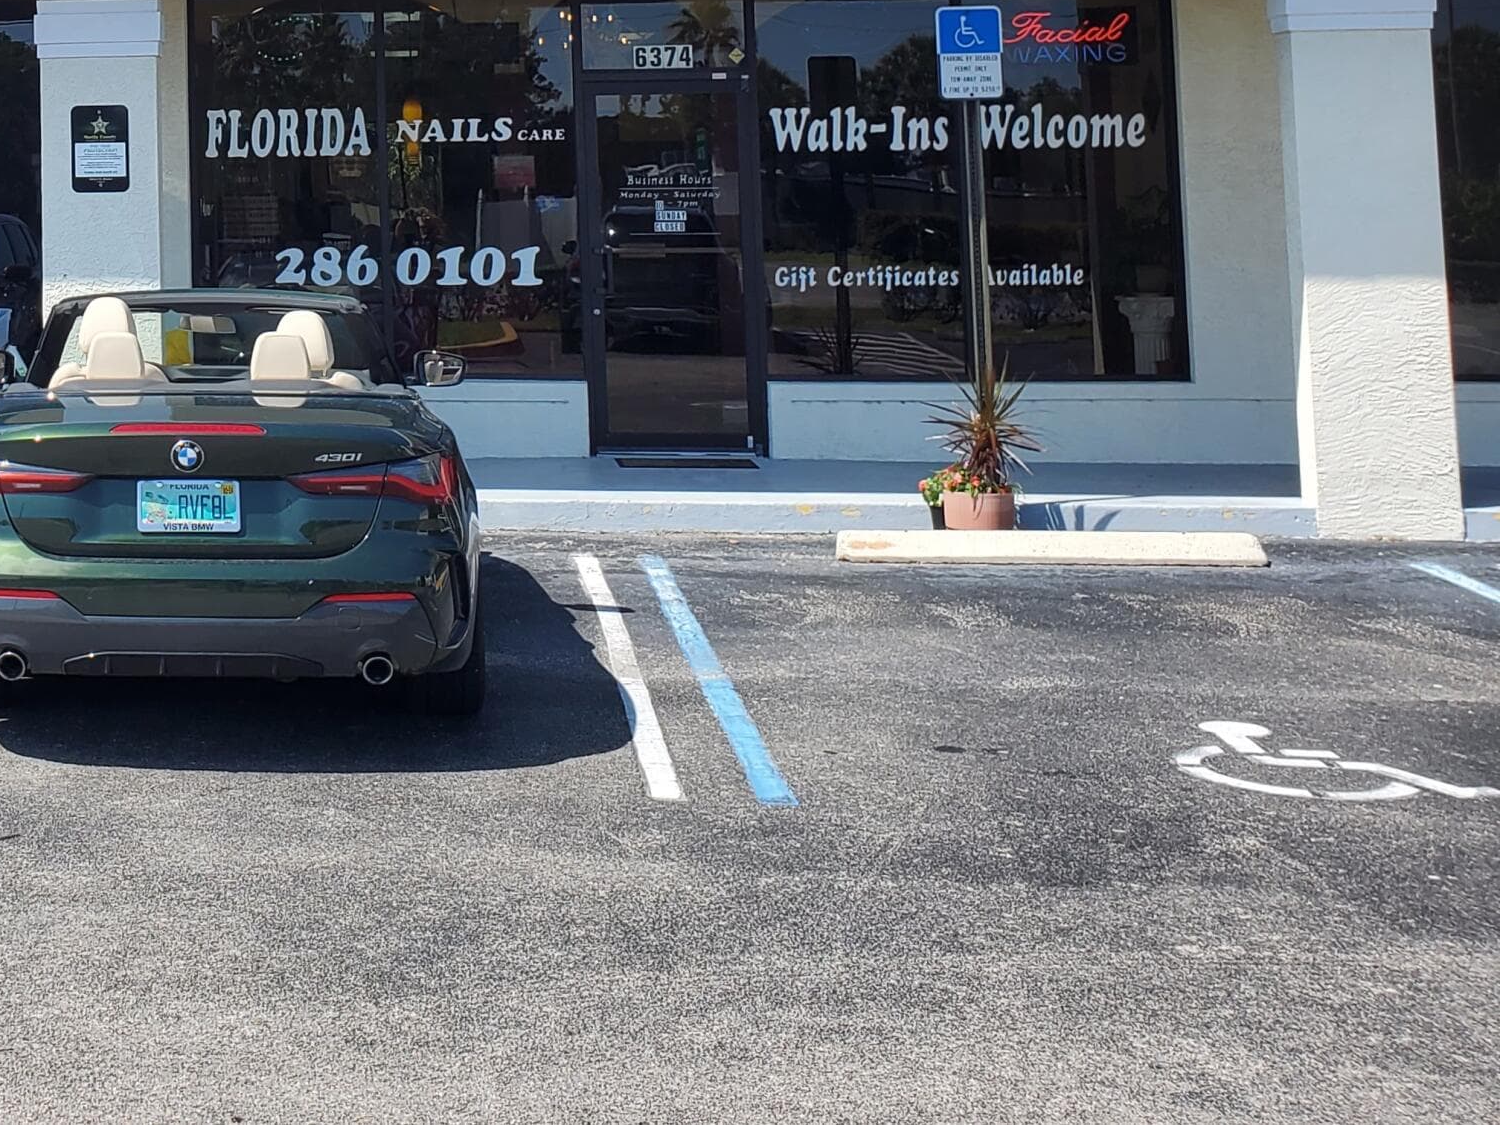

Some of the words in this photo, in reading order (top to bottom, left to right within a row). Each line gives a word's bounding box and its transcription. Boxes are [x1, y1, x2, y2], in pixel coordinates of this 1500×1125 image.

[1003, 12, 1129, 43] Facial
[635, 46, 692, 67] 6374
[1007, 42, 1126, 64] WAXING
[205, 107, 371, 158] FLORIDA
[396, 117, 513, 143] NAILS
[517, 128, 565, 142] CARE
[769, 105, 949, 153] Walk-Ins
[979, 103, 1146, 150] Welcome
[627, 175, 674, 185] Business
[680, 174, 712, 185] Hours
[620, 191, 659, 200] Monday
[673, 190, 720, 199] Saturday
[677, 200, 698, 208] 7pm
[656, 211, 687, 221] SUNDAY
[655, 222, 685, 232] CLOSED
[274, 245, 379, 287] 286
[396, 246, 544, 286] 0101
[774, 266, 817, 291] Gift
[827, 266, 959, 291] Certificates
[163, 523, 190, 531] VISTA
[191, 523, 214, 531] BMW
